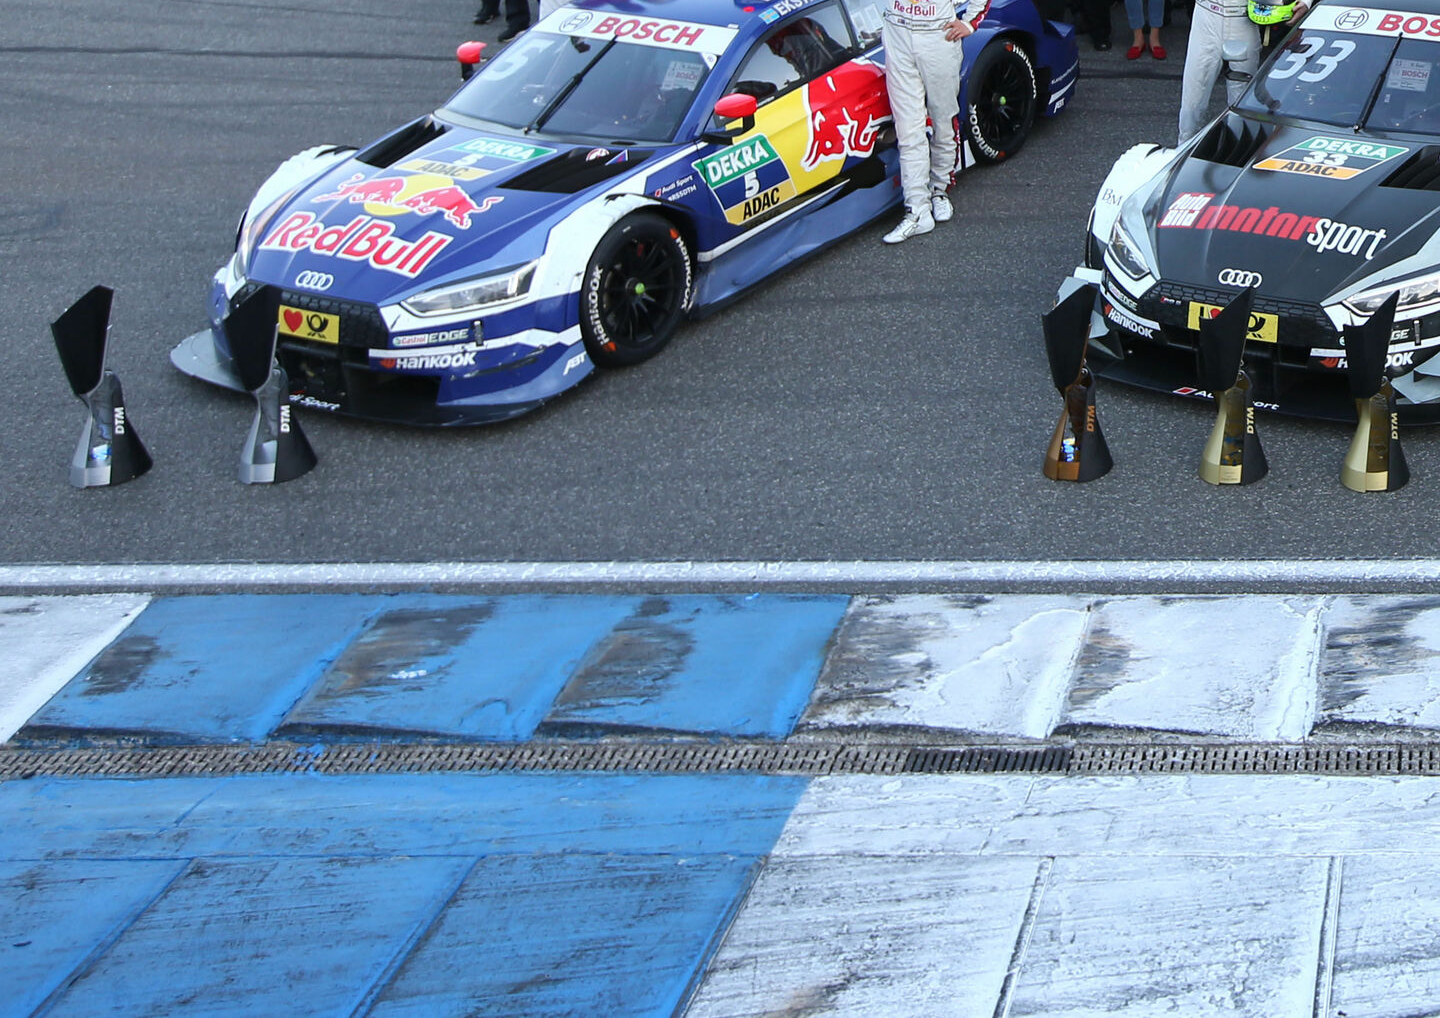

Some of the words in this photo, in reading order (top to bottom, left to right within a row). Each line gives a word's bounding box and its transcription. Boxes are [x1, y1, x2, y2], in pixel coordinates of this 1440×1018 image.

[894, 0, 912, 14] Red
[914, 4, 935, 16] Bull
[592, 16, 705, 46] BOSCH
[1268, 36, 1357, 83] 33
[1401, 69, 1428, 79] BOSCH
[464, 138, 536, 160] DEKRA
[1303, 150, 1348, 166] 33
[1312, 138, 1388, 159] DEKRA
[416, 161, 467, 178] ADAC
[460, 153, 483, 166] 5
[707, 141, 769, 183] DEKRA
[1280, 160, 1338, 177] ADAC
[662, 182, 676, 194] Audi
[676, 175, 694, 188] Sport
[745, 169, 760, 198] 5
[743, 187, 780, 221] ADAC
[1168, 193, 1213, 210] Auto
[1160, 209, 1202, 227] Bild
[263, 213, 366, 255] Red
[342, 219, 452, 275] Bull
[429, 328, 469, 343] EDGE
[300, 395, 341, 411] Sport
[114, 406, 125, 435] DTM
[280, 404, 290, 433] DTM
[1086, 404, 1096, 432] DTM
[1391, 412, 1399, 440] DTM
